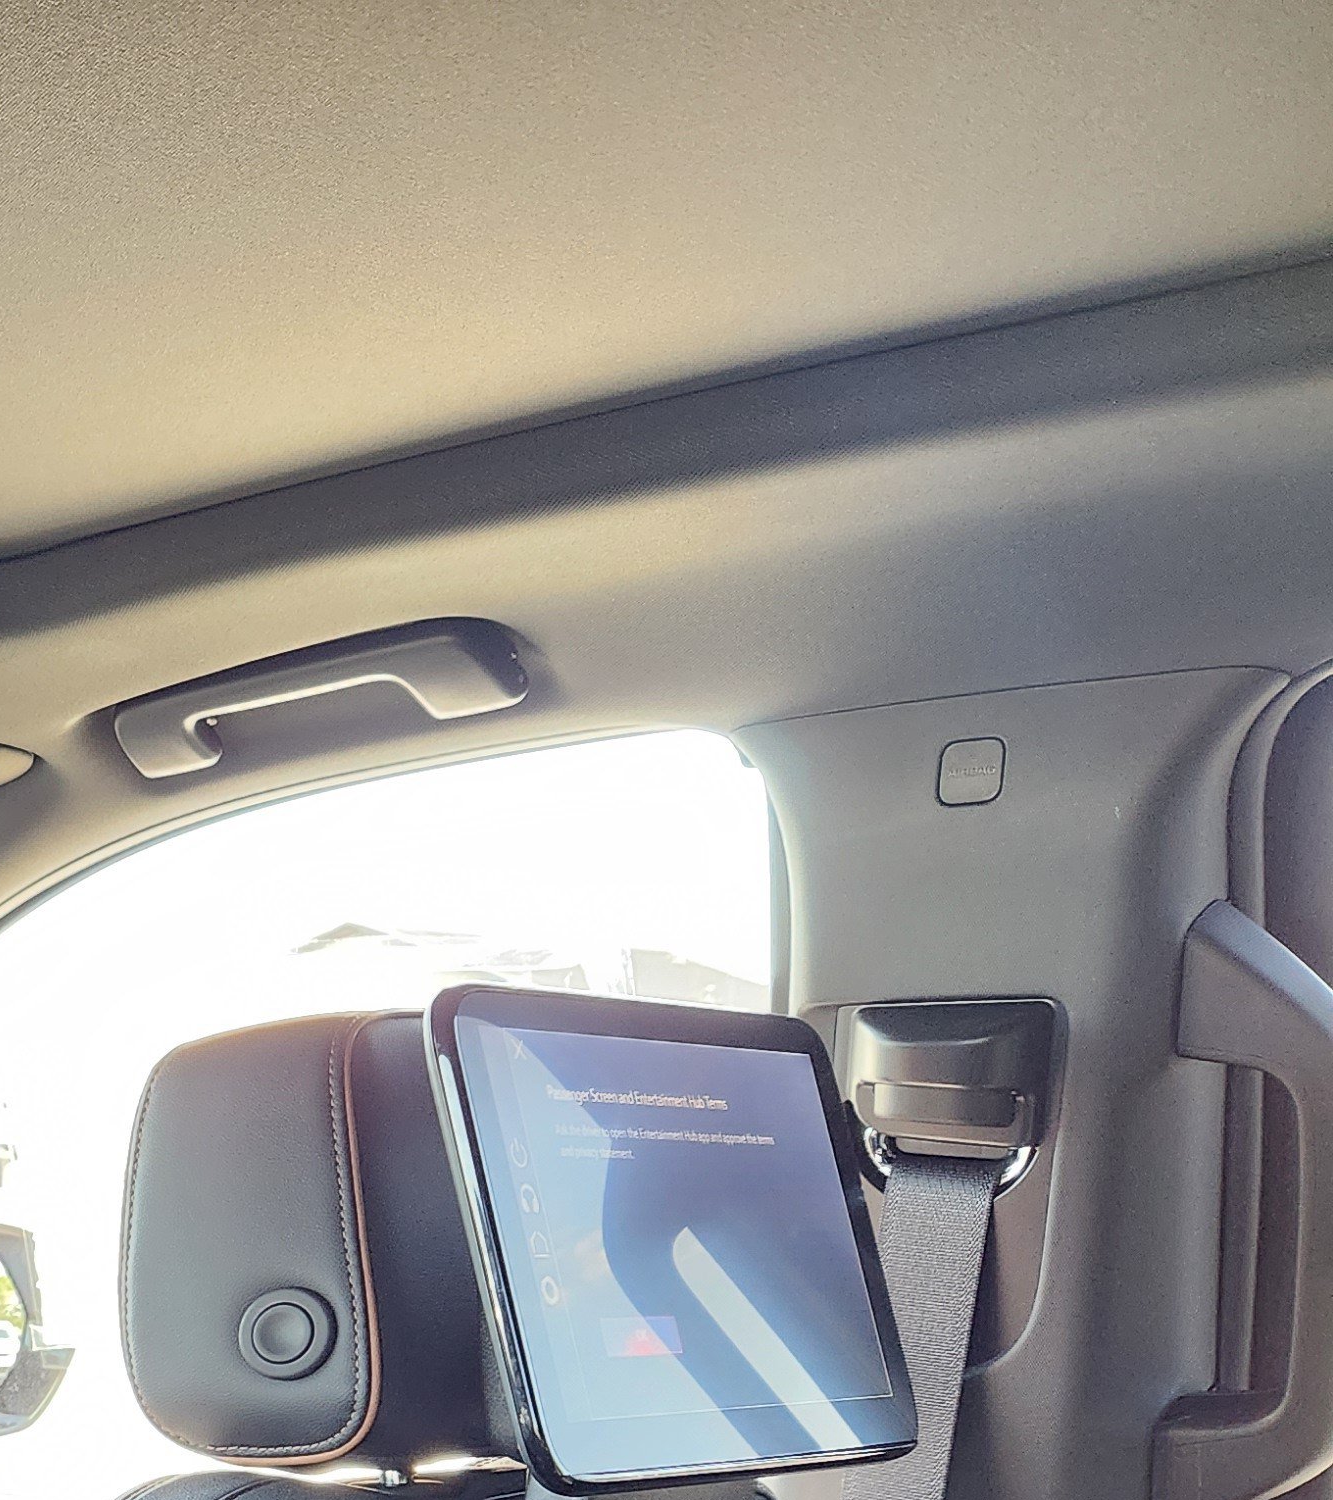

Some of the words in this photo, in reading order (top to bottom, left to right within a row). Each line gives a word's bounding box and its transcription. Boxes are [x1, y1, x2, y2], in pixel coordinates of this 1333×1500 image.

[947, 764, 997, 778] AIRBAG
[546, 1085, 589, 1106] Passenger
[589, 1088, 618, 1104] Screen
[618, 1090, 635, 1105] and
[635, 1091, 689, 1109] Entertainment
[689, 1095, 705, 1109] Hub
[703, 1095, 728, 1110] Terms
[639, 1128, 684, 1141] Entertainment
